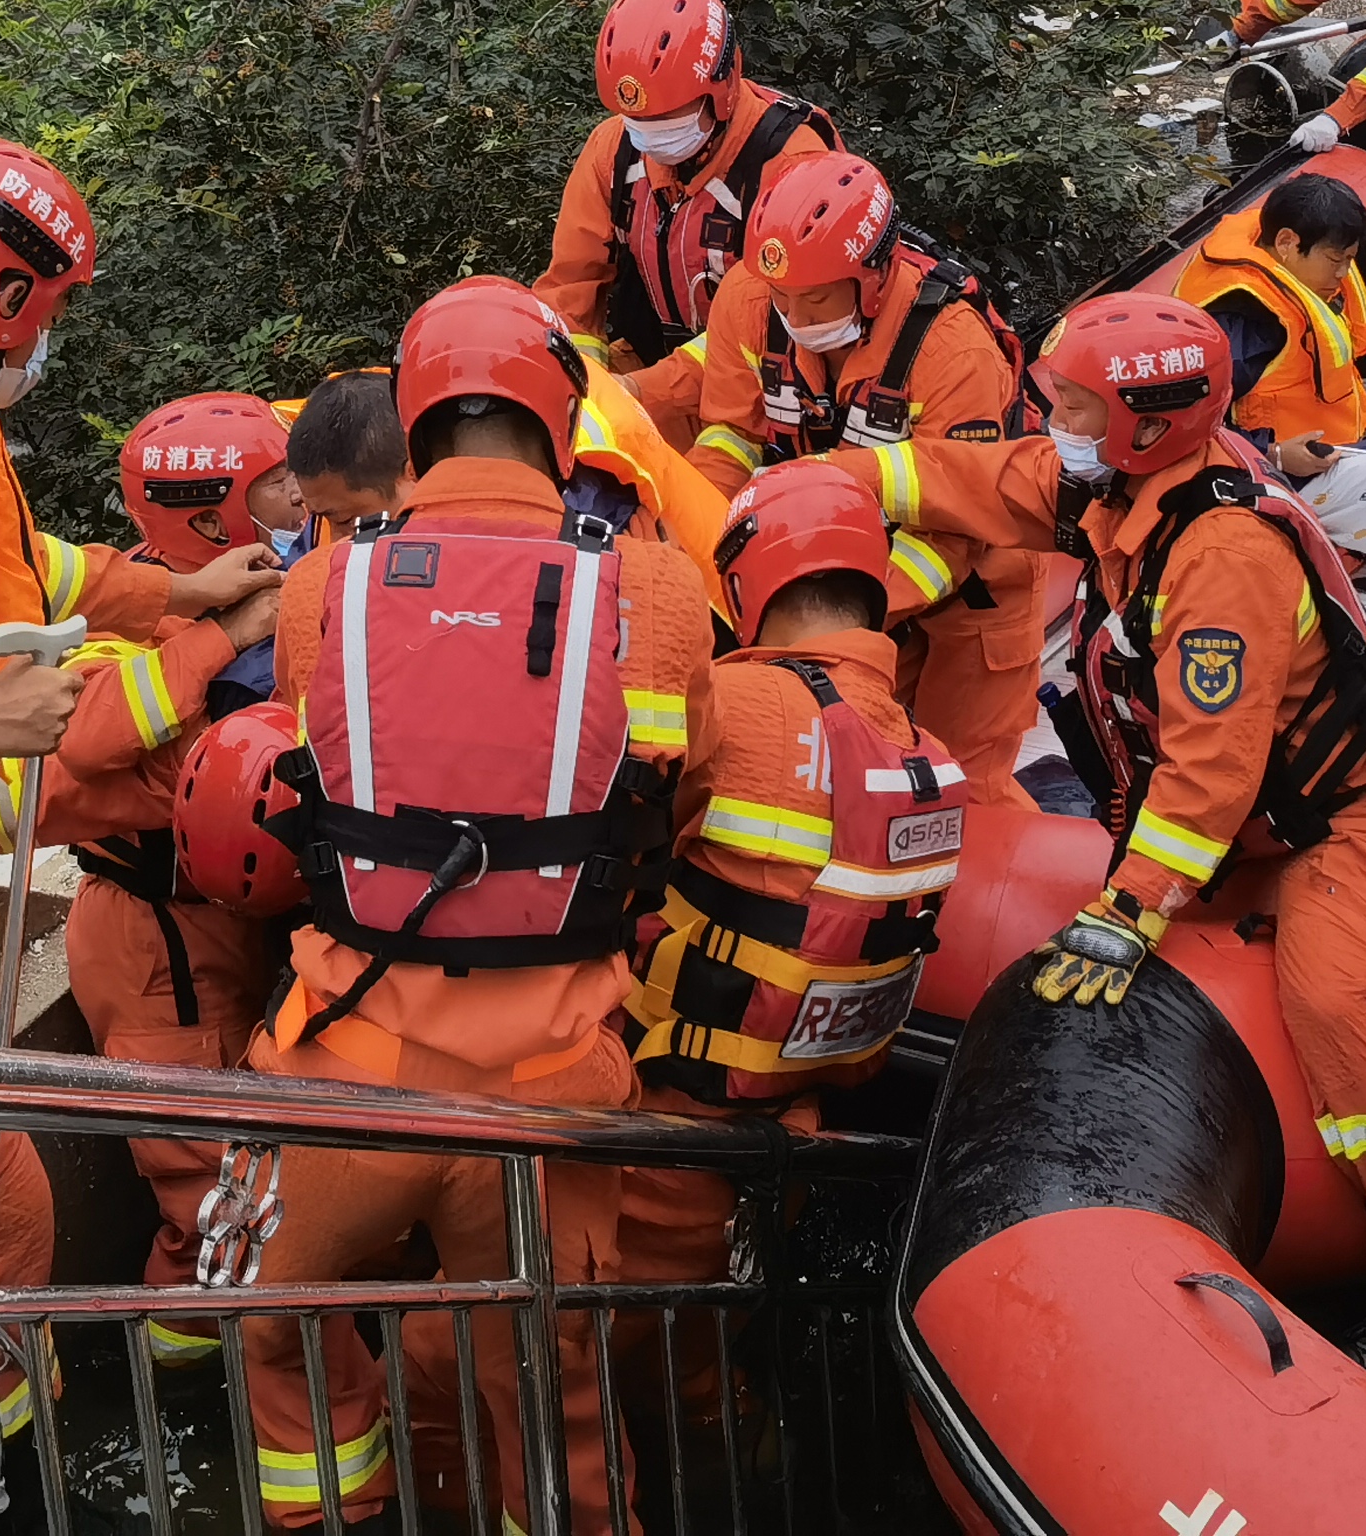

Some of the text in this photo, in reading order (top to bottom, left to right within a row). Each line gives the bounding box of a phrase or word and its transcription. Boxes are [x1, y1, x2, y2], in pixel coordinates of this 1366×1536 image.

[843, 181, 889, 263] 北京消防
[1104, 343, 1205, 384] 北京消防
[430, 609, 502, 628] NRS
